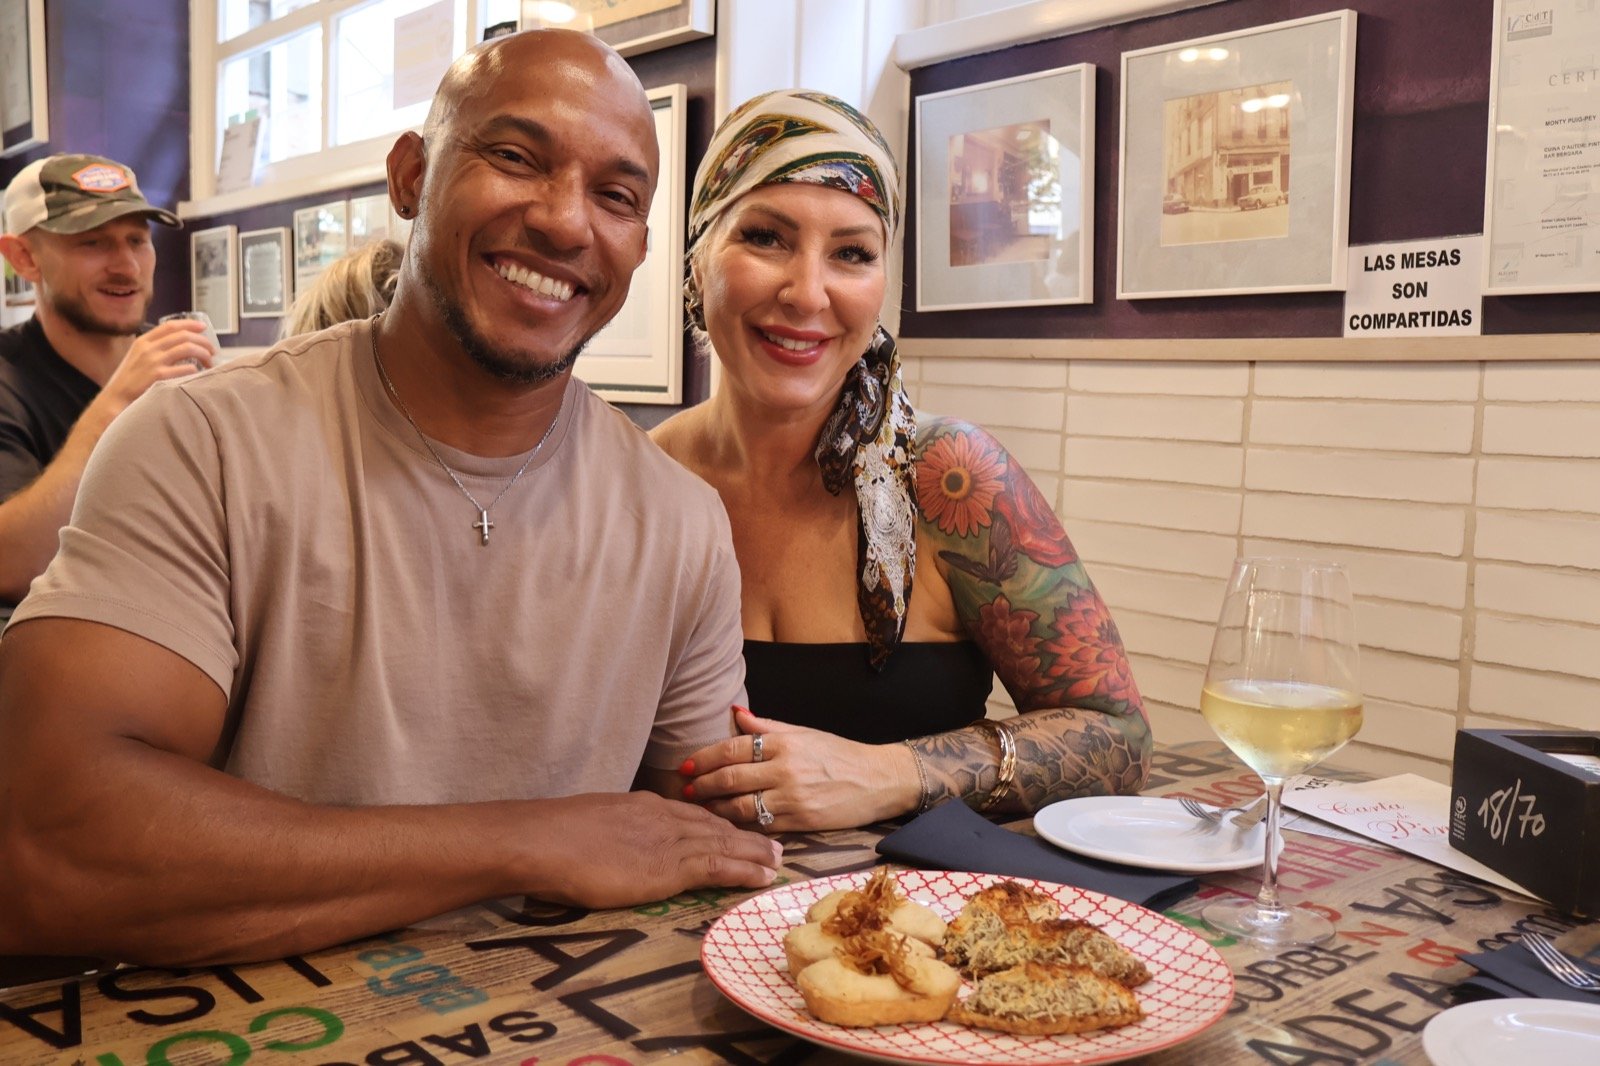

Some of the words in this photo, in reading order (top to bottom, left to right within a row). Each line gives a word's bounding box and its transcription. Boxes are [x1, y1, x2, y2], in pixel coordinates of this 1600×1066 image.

[1364, 253, 1396, 273] LAS
[1400, 249, 1461, 270] MESAS
[1392, 281, 1428, 300] SON
[1349, 309, 1473, 331] COMPARTIDAS
[1317, 800, 1406, 816] Carta
[1477, 778, 1546, 846] 18/70
[96, 1006, 346, 1066] CO
[315, 1010, 558, 1066] SAB
